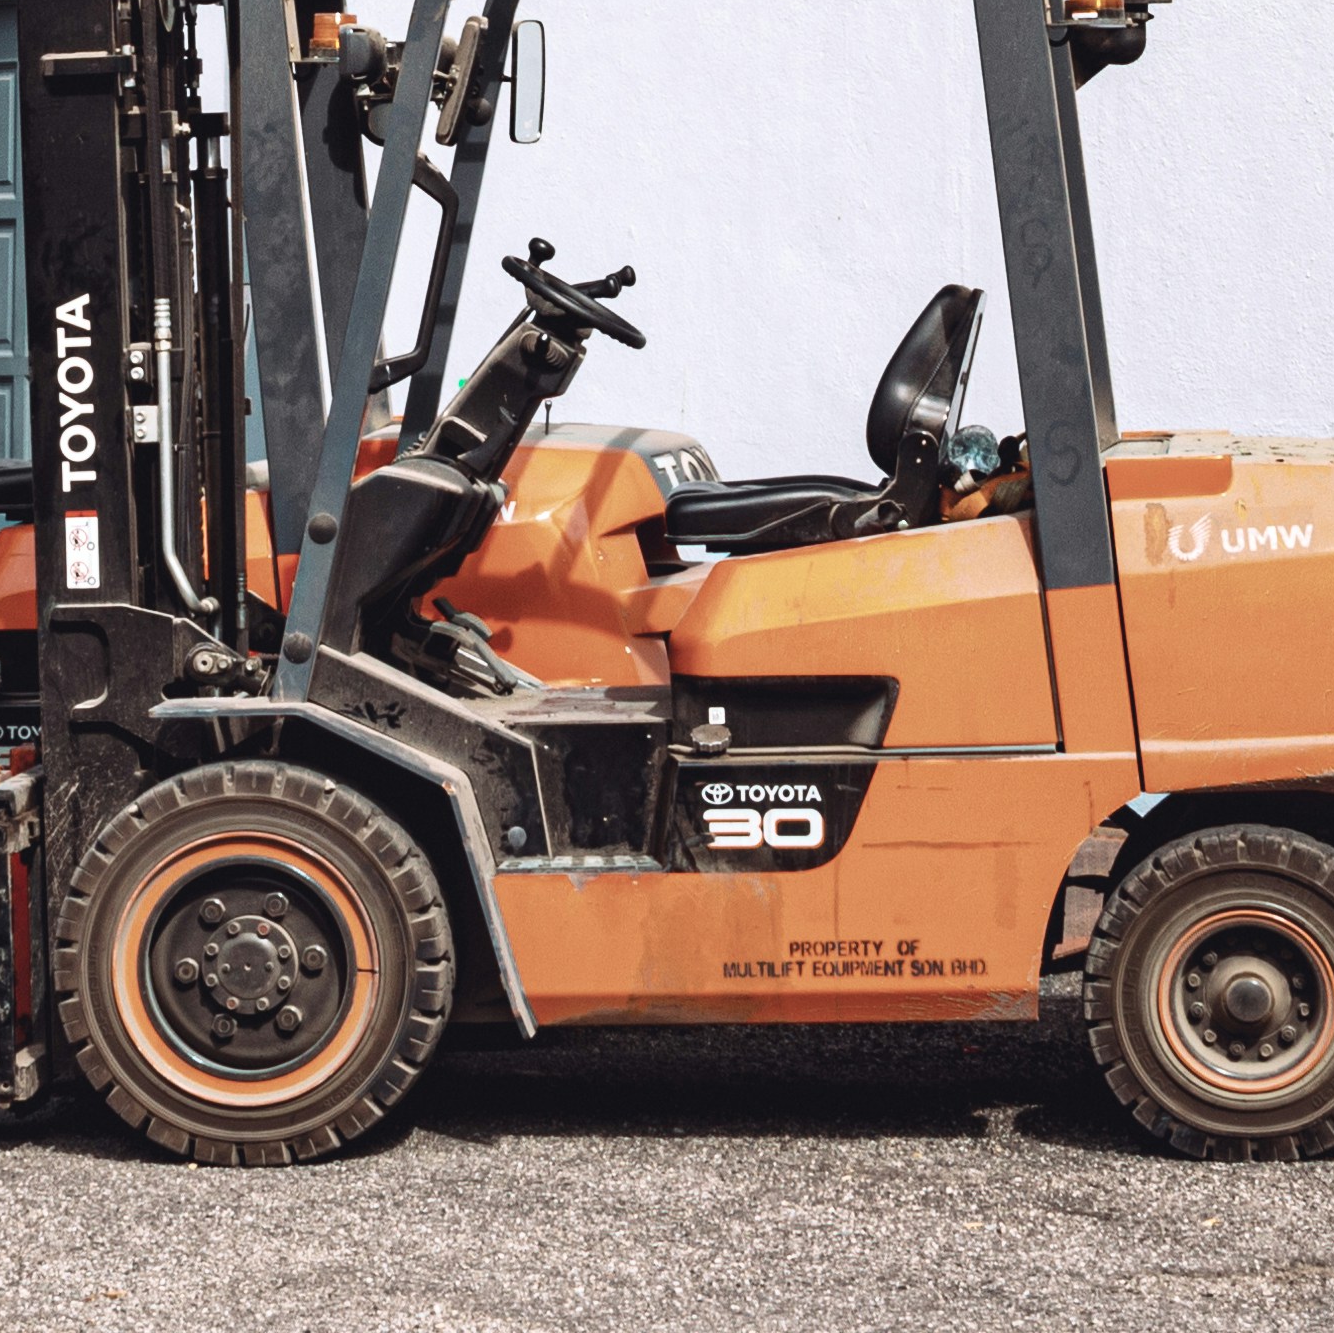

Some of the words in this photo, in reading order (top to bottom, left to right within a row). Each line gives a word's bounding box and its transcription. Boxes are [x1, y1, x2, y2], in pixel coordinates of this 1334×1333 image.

[56, 293, 96, 493] TOYOTA
[1220, 523, 1314, 553] UMW
[735, 784, 822, 803] TOYOTA
[703, 808, 824, 849] 30
[789, 940, 884, 958] PROPERTY
[896, 940, 921, 957] OF
[722, 960, 805, 979] MULTILIFT
[812, 959, 905, 977] EQUIPMENT
